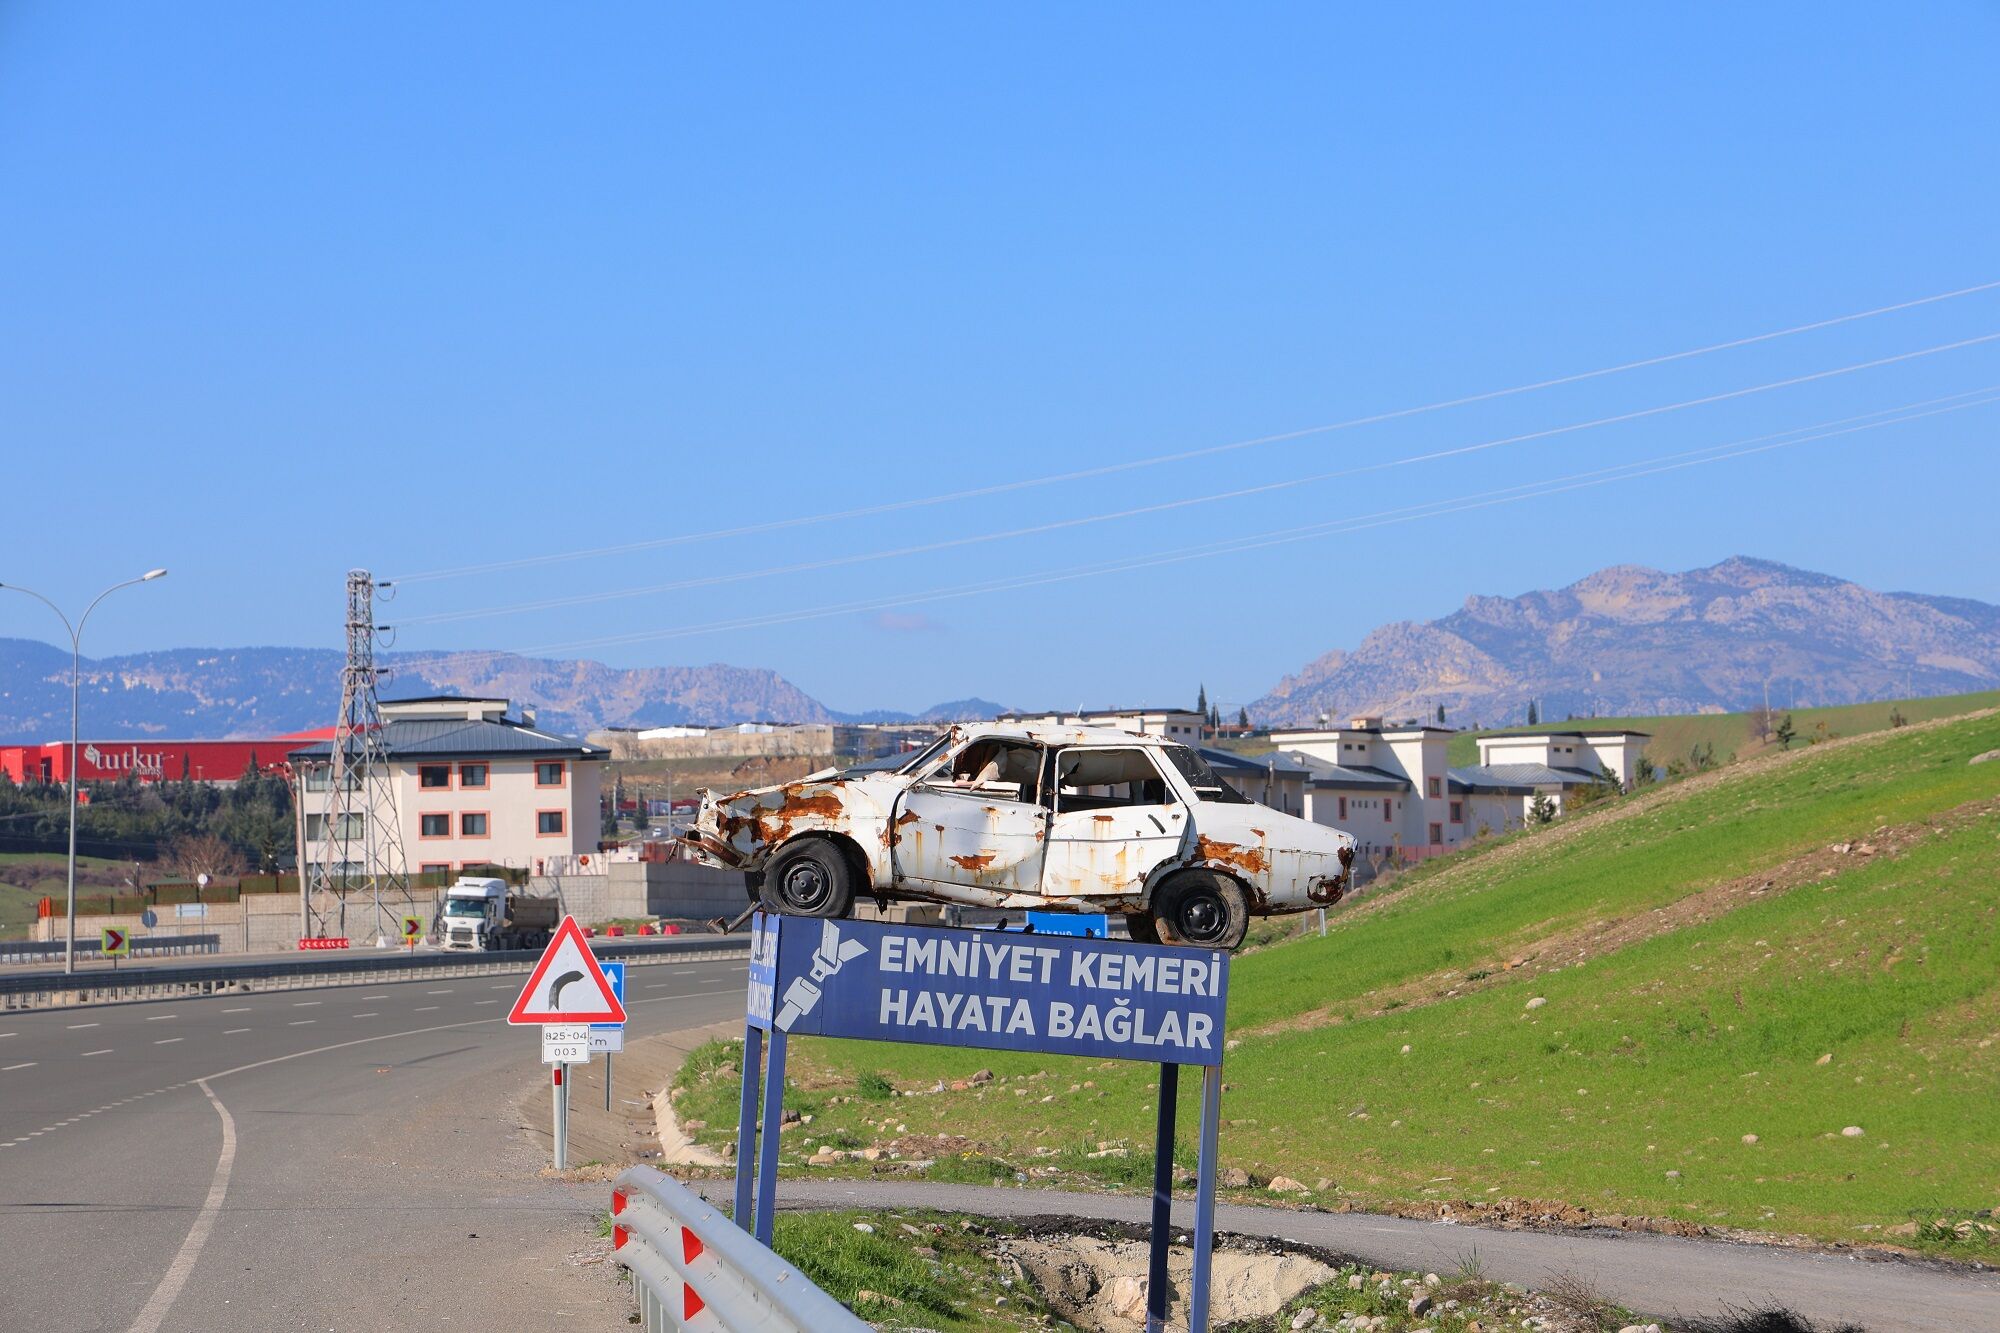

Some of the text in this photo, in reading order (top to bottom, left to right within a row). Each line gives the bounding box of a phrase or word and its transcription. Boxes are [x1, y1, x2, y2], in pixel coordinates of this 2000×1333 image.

[95, 746, 161, 769] tutku
[879, 934, 1221, 997] EMNİYET KEMERİ
[879, 988, 1213, 1049] HAYATA BAĞLAR
[545, 1031, 588, 1041] 825-04
[554, 1047, 577, 1056] 003
